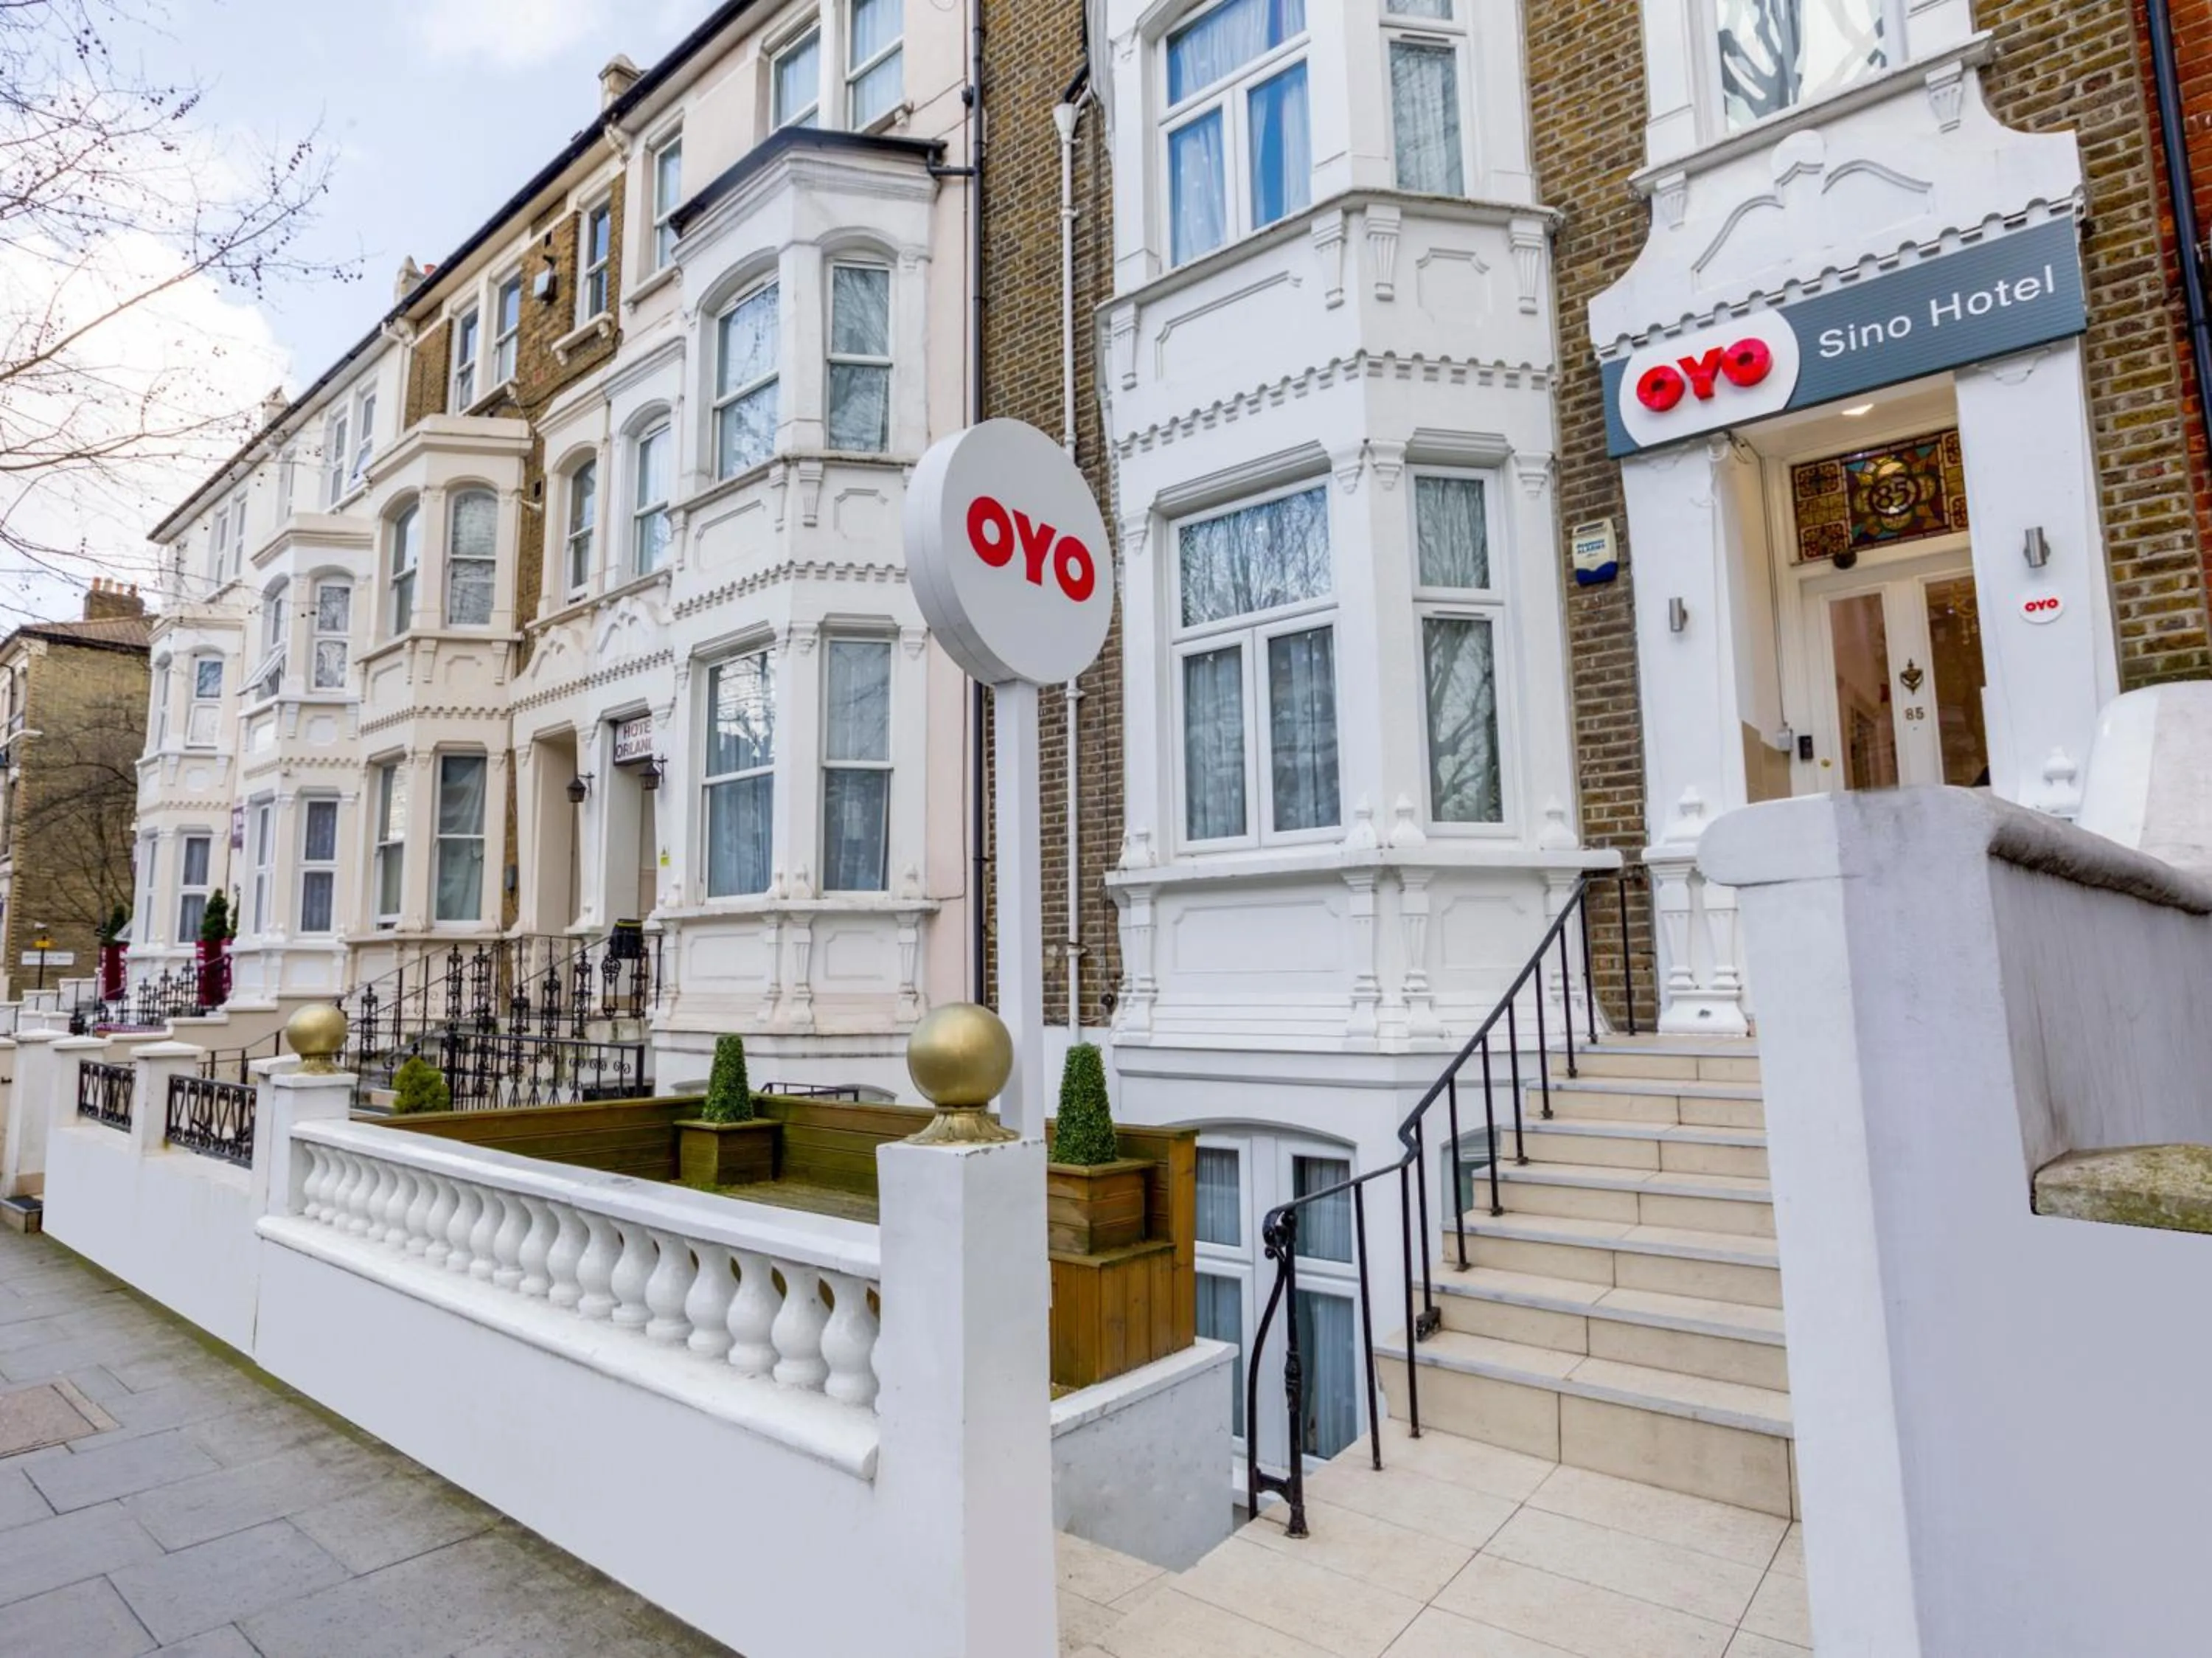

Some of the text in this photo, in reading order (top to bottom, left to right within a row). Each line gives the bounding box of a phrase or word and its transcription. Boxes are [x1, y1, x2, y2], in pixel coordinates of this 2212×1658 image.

[1819, 264, 2054, 358] Sino Hotel
[1636, 338, 1773, 412] OYO
[1876, 471, 1910, 508] 85
[967, 496, 1095, 602] OYO
[2025, 598, 2059, 612] OYO
[1905, 707, 1924, 721] 85
